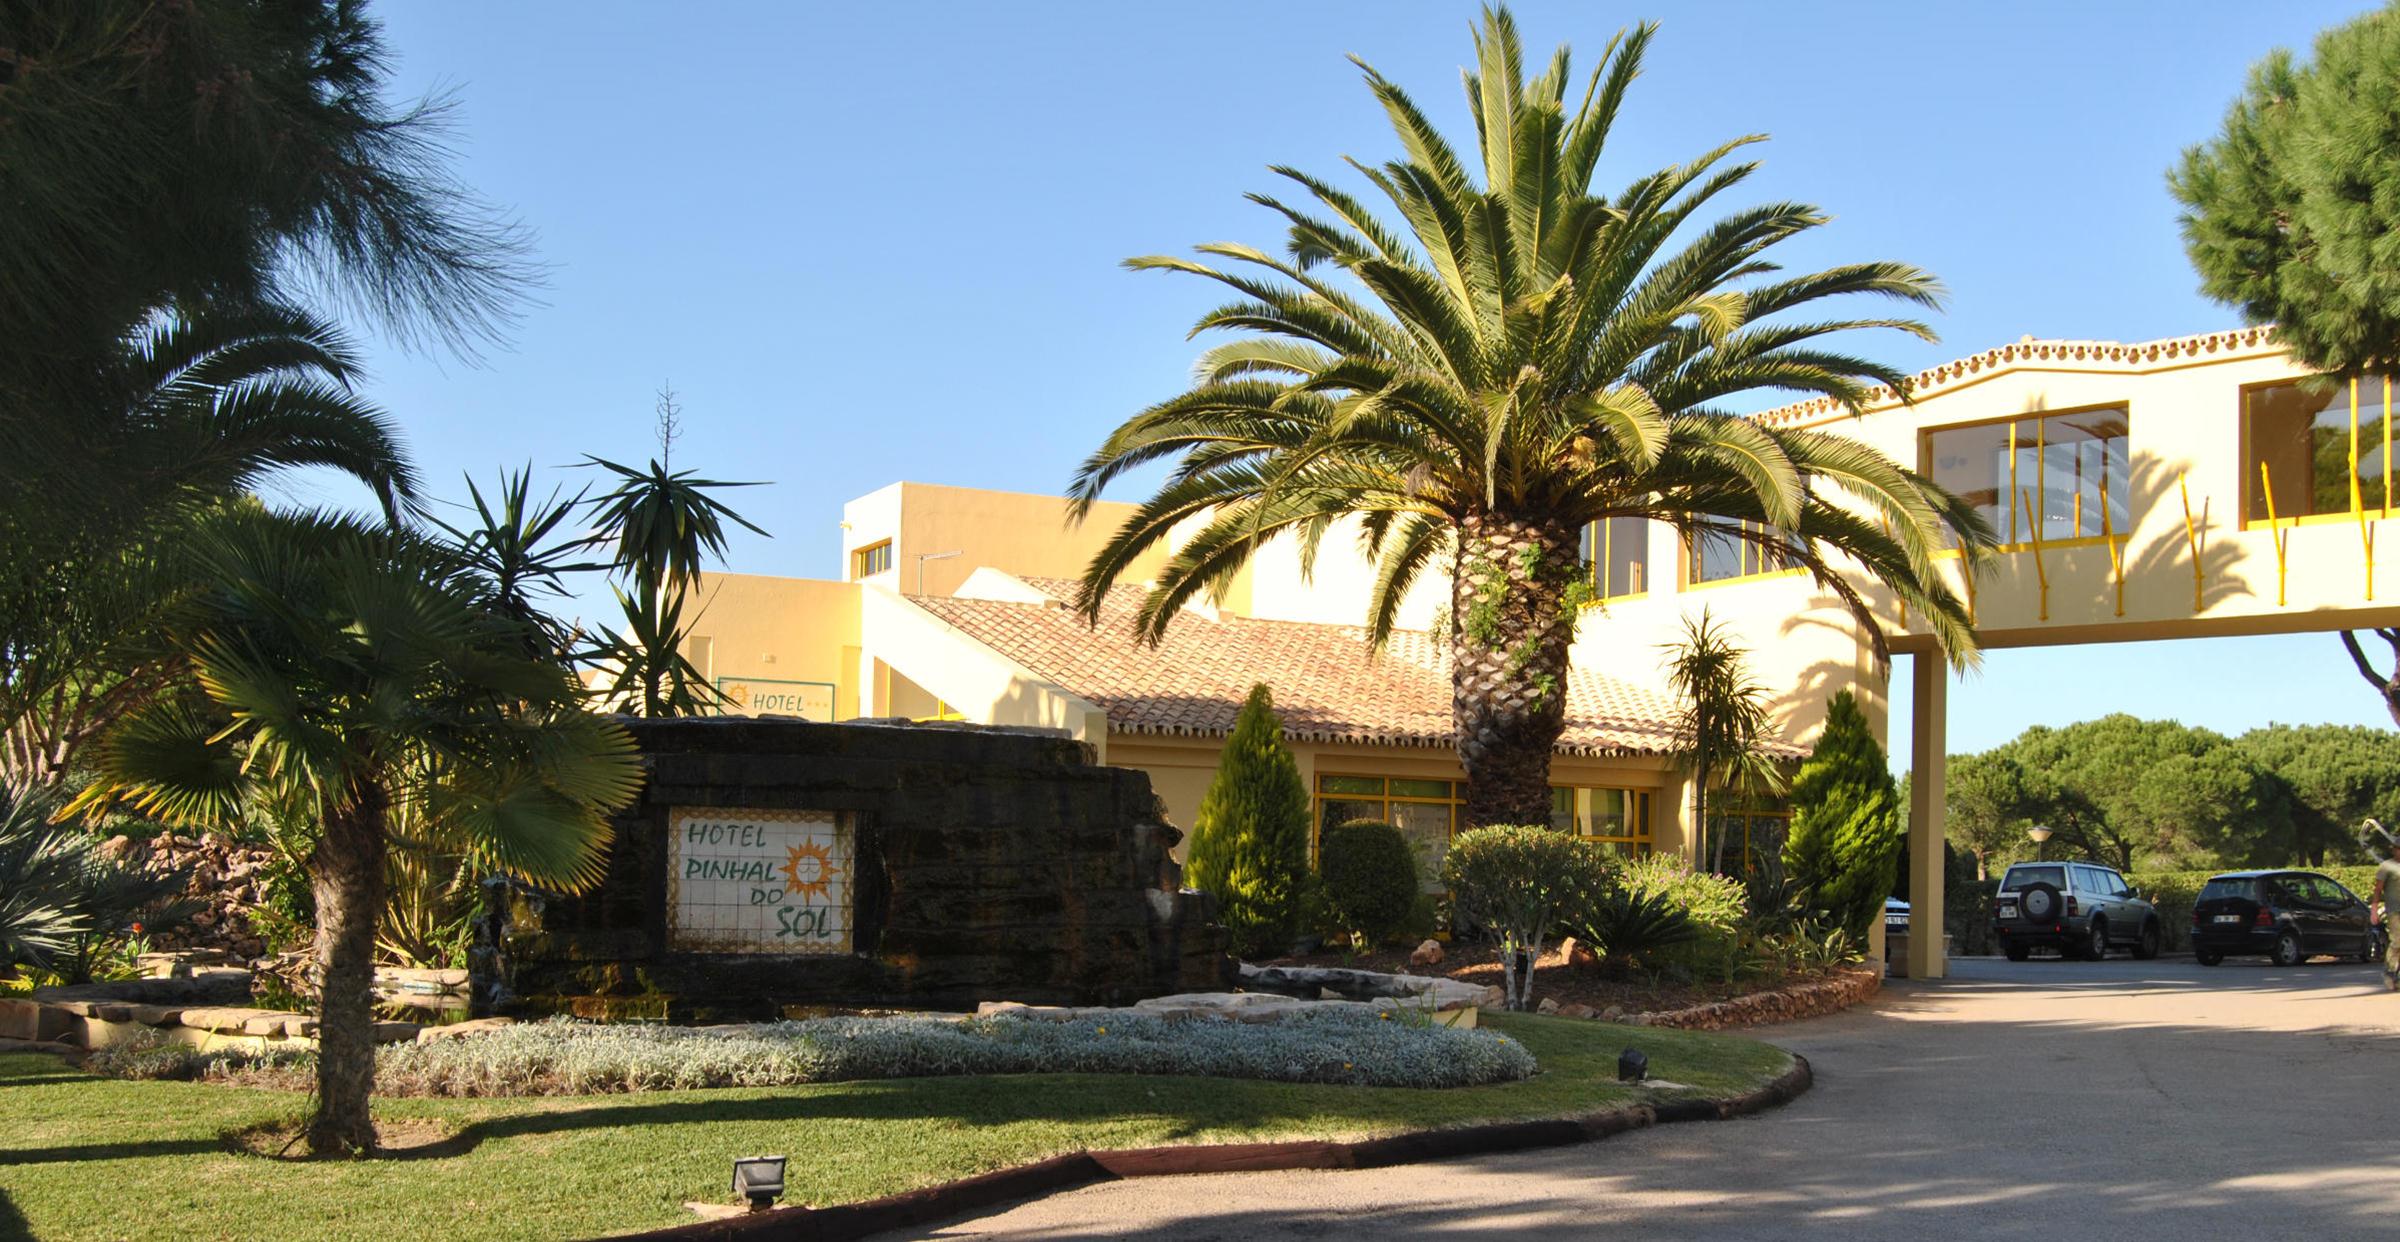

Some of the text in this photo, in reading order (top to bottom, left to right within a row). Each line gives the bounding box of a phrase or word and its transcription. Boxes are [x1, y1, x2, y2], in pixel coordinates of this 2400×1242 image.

[753, 693, 804, 712] HOTEL
[687, 822, 766, 848] HOTEL
[685, 857, 777, 882] PINHAL
[750, 887, 784, 905] DO
[775, 905, 831, 938] SOL
